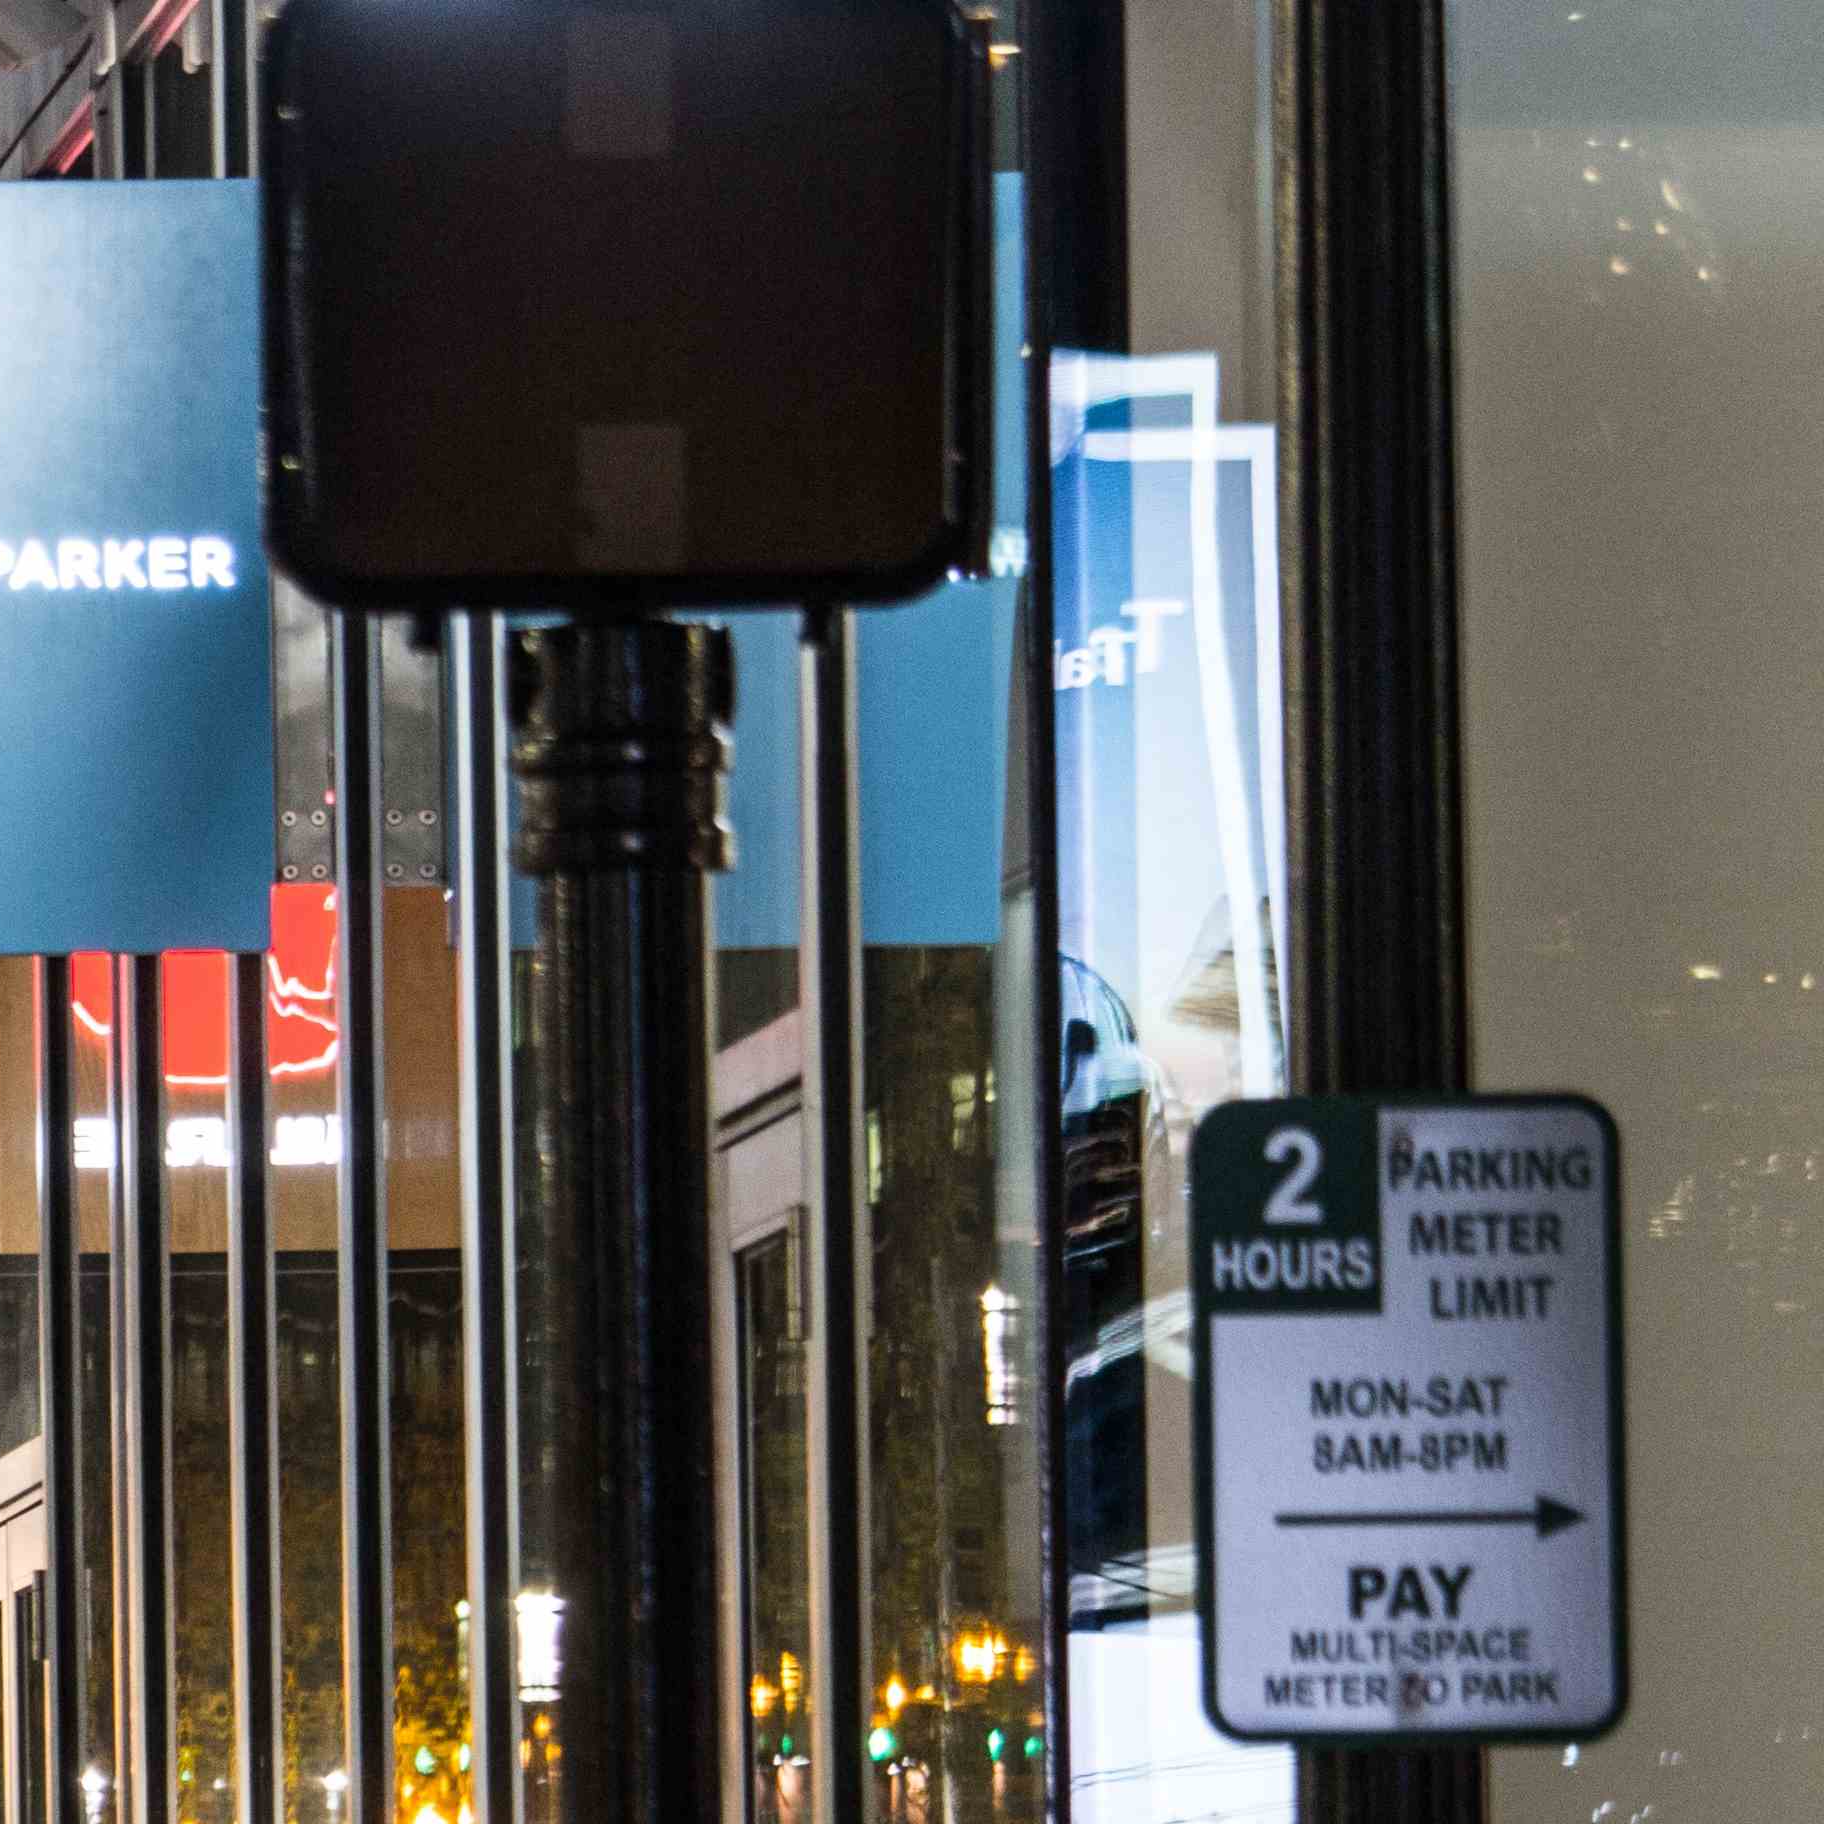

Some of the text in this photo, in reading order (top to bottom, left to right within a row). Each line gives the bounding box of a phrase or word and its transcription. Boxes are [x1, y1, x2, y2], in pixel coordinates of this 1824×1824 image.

[1263, 1126, 1324, 1225] 2
[1387, 1148, 1594, 1191] PARKING
[1409, 1212, 1564, 1255] METER
[1212, 1240, 1373, 1291] HOURS
[1431, 1277, 1554, 1319] LIMIT
[1310, 1377, 1507, 1418] MON-SAT
[1313, 1431, 1509, 1473] 8AM-8PM
[1347, 1564, 1474, 1620] PAY
[1290, 1627, 1532, 1662] MULTI-SPACE
[1265, 1673, 1387, 1706] METER
[1460, 1672, 1560, 1704] PARK
